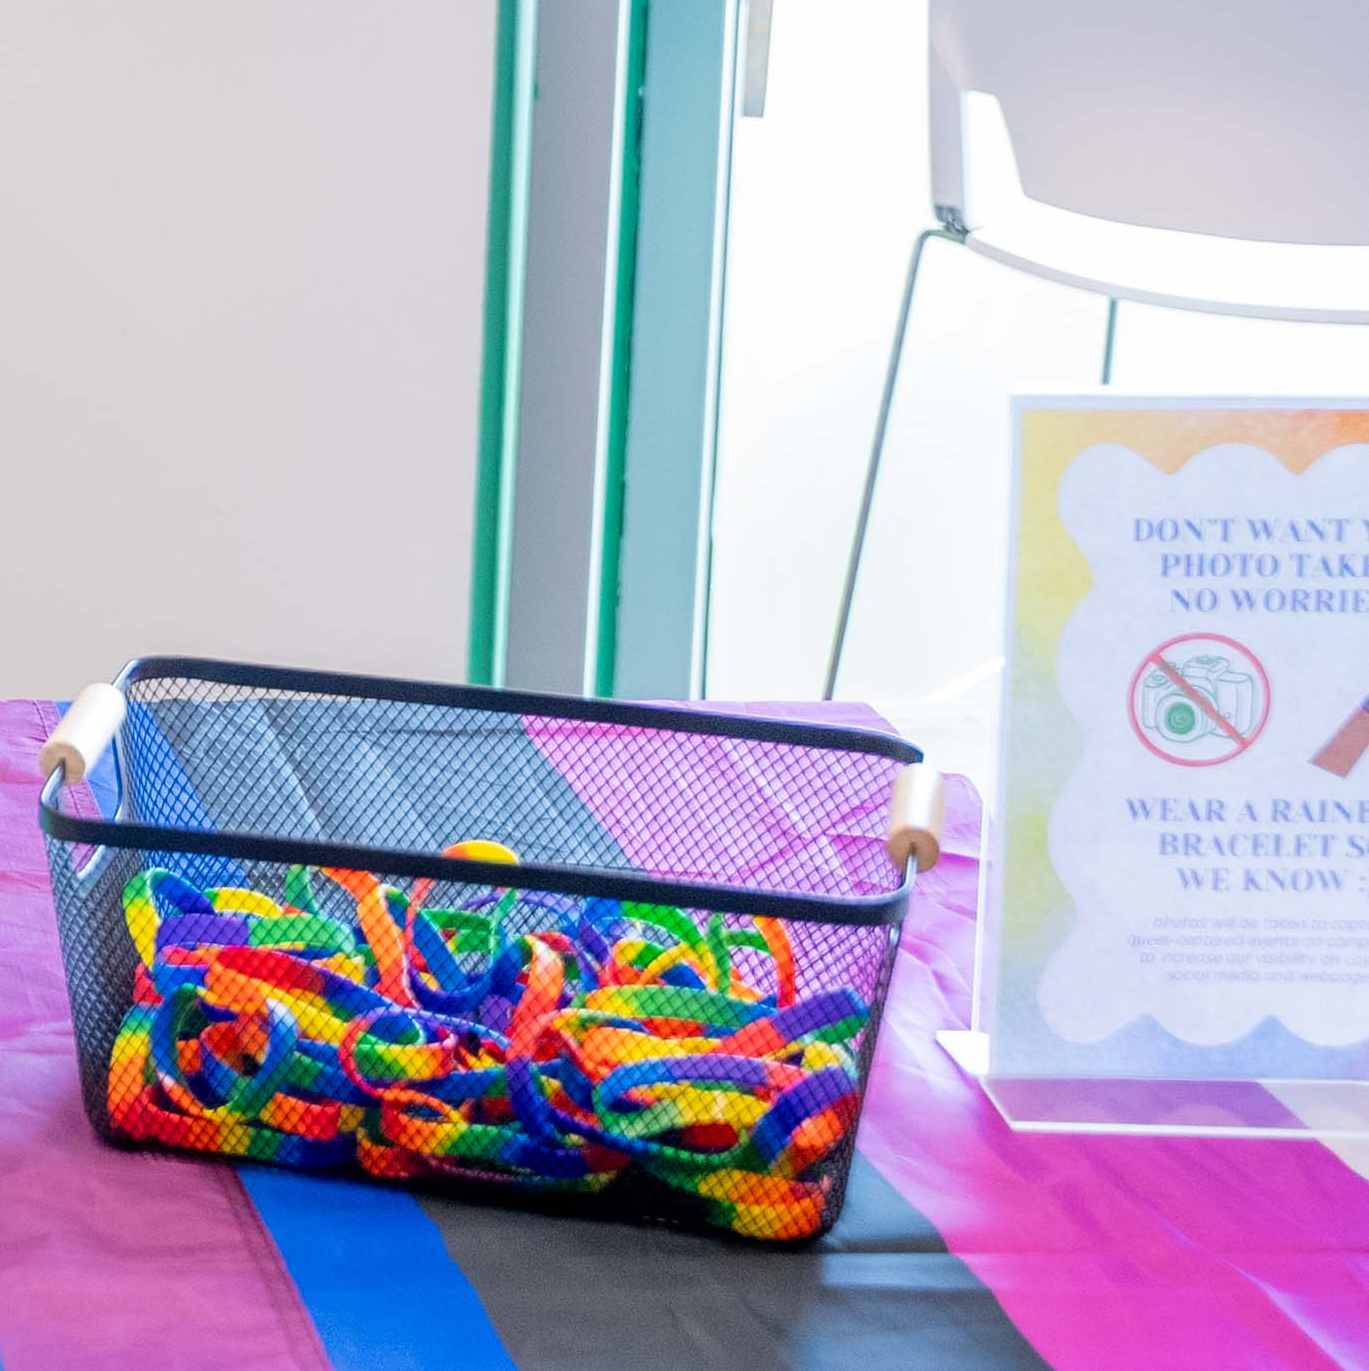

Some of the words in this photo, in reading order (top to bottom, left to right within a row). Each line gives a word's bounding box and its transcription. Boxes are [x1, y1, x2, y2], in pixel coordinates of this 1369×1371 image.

[1132, 517, 1235, 542] DON'T
[1246, 518, 1350, 542] WANT
[1159, 553, 1280, 578] PHOTO
[1170, 588, 1219, 612] NO
[1124, 797, 1227, 822] WEAR
[1235, 799, 1260, 822] A
[1158, 832, 1335, 858] BRACELET
[1345, 834, 1369, 858] S
[1175, 867, 1230, 892] WE
[1241, 868, 1349, 892] KNOW
[1311, 917, 1326, 930] to
